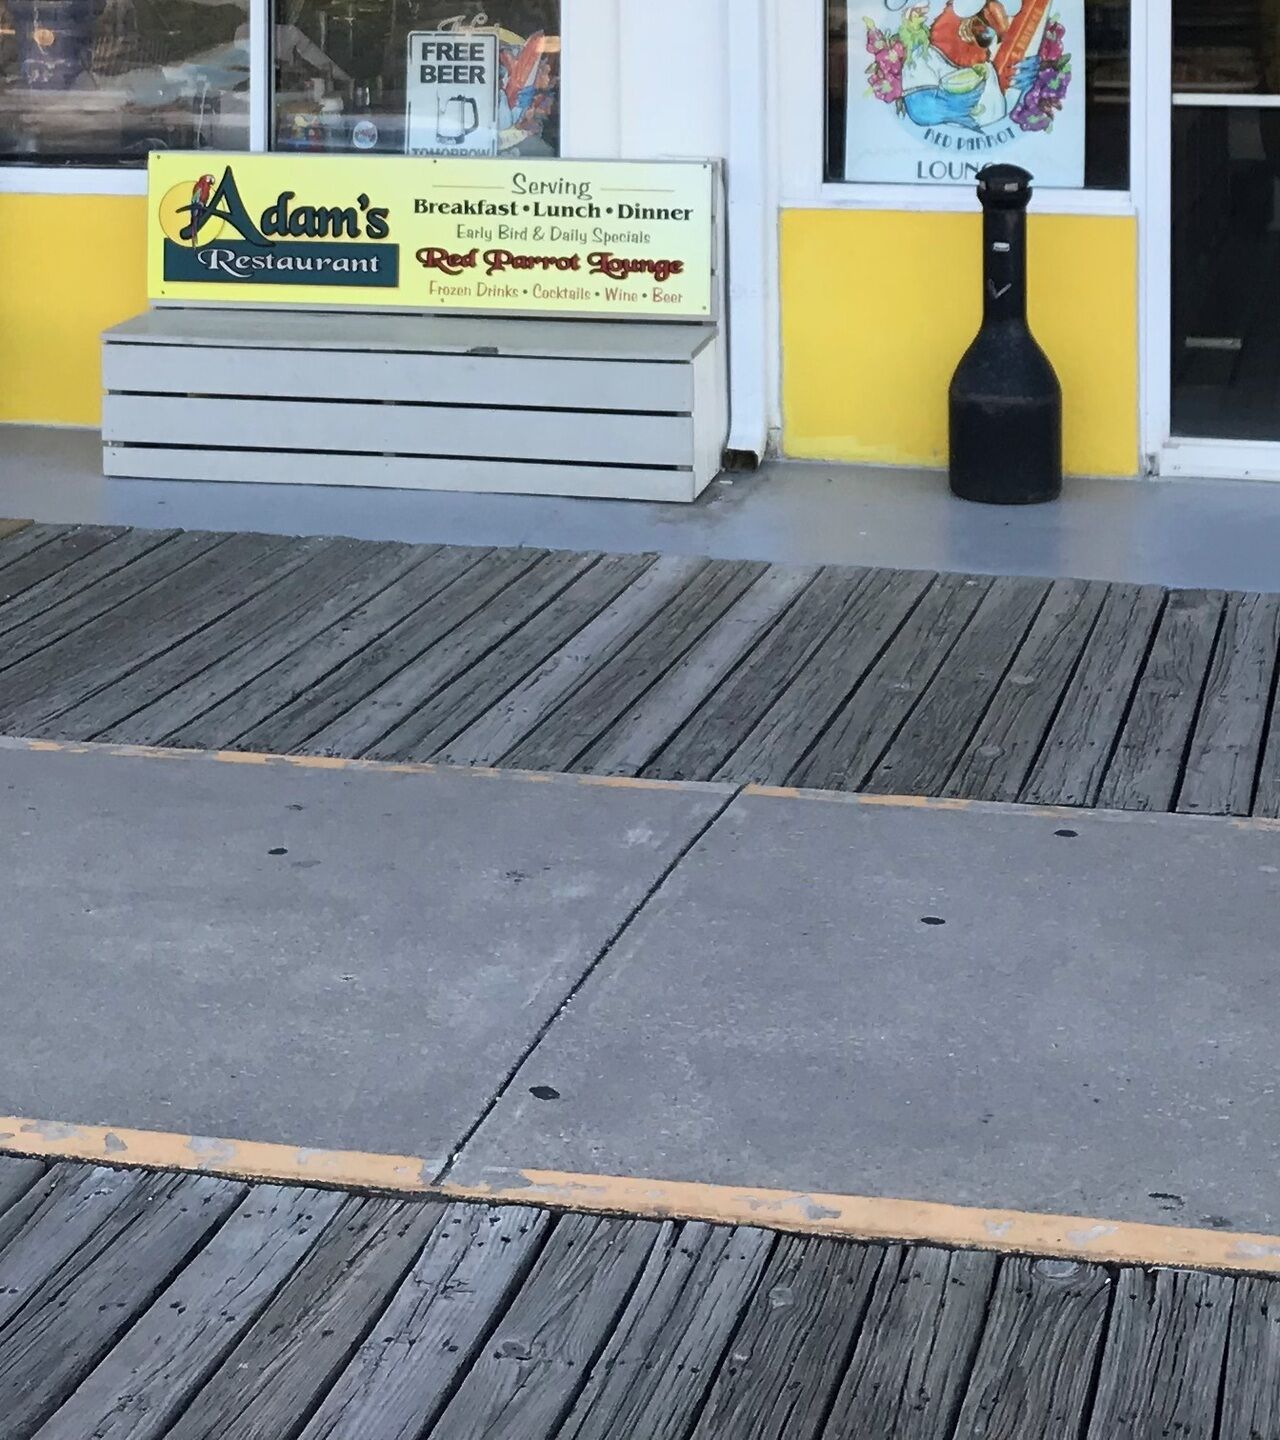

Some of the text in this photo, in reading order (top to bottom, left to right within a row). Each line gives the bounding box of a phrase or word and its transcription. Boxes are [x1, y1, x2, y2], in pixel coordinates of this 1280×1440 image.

[422, 42, 485, 61] FREE
[420, 65, 486, 84] BEER
[924, 127, 1015, 150] RED PARROT
[917, 160, 992, 180] LOUN
[511, 172, 593, 200] Serving
[175, 165, 390, 247] Adam's
[414, 198, 693, 221] Breakfast Lunch Dinner
[457, 224, 651, 245] Early Bird & Daily Specials
[197, 249, 379, 278] Restaurant
[415, 247, 684, 282] Red Parrot Lounge
[429, 280, 683, 304] Frozen Drinks Cocktails Wine Beer
